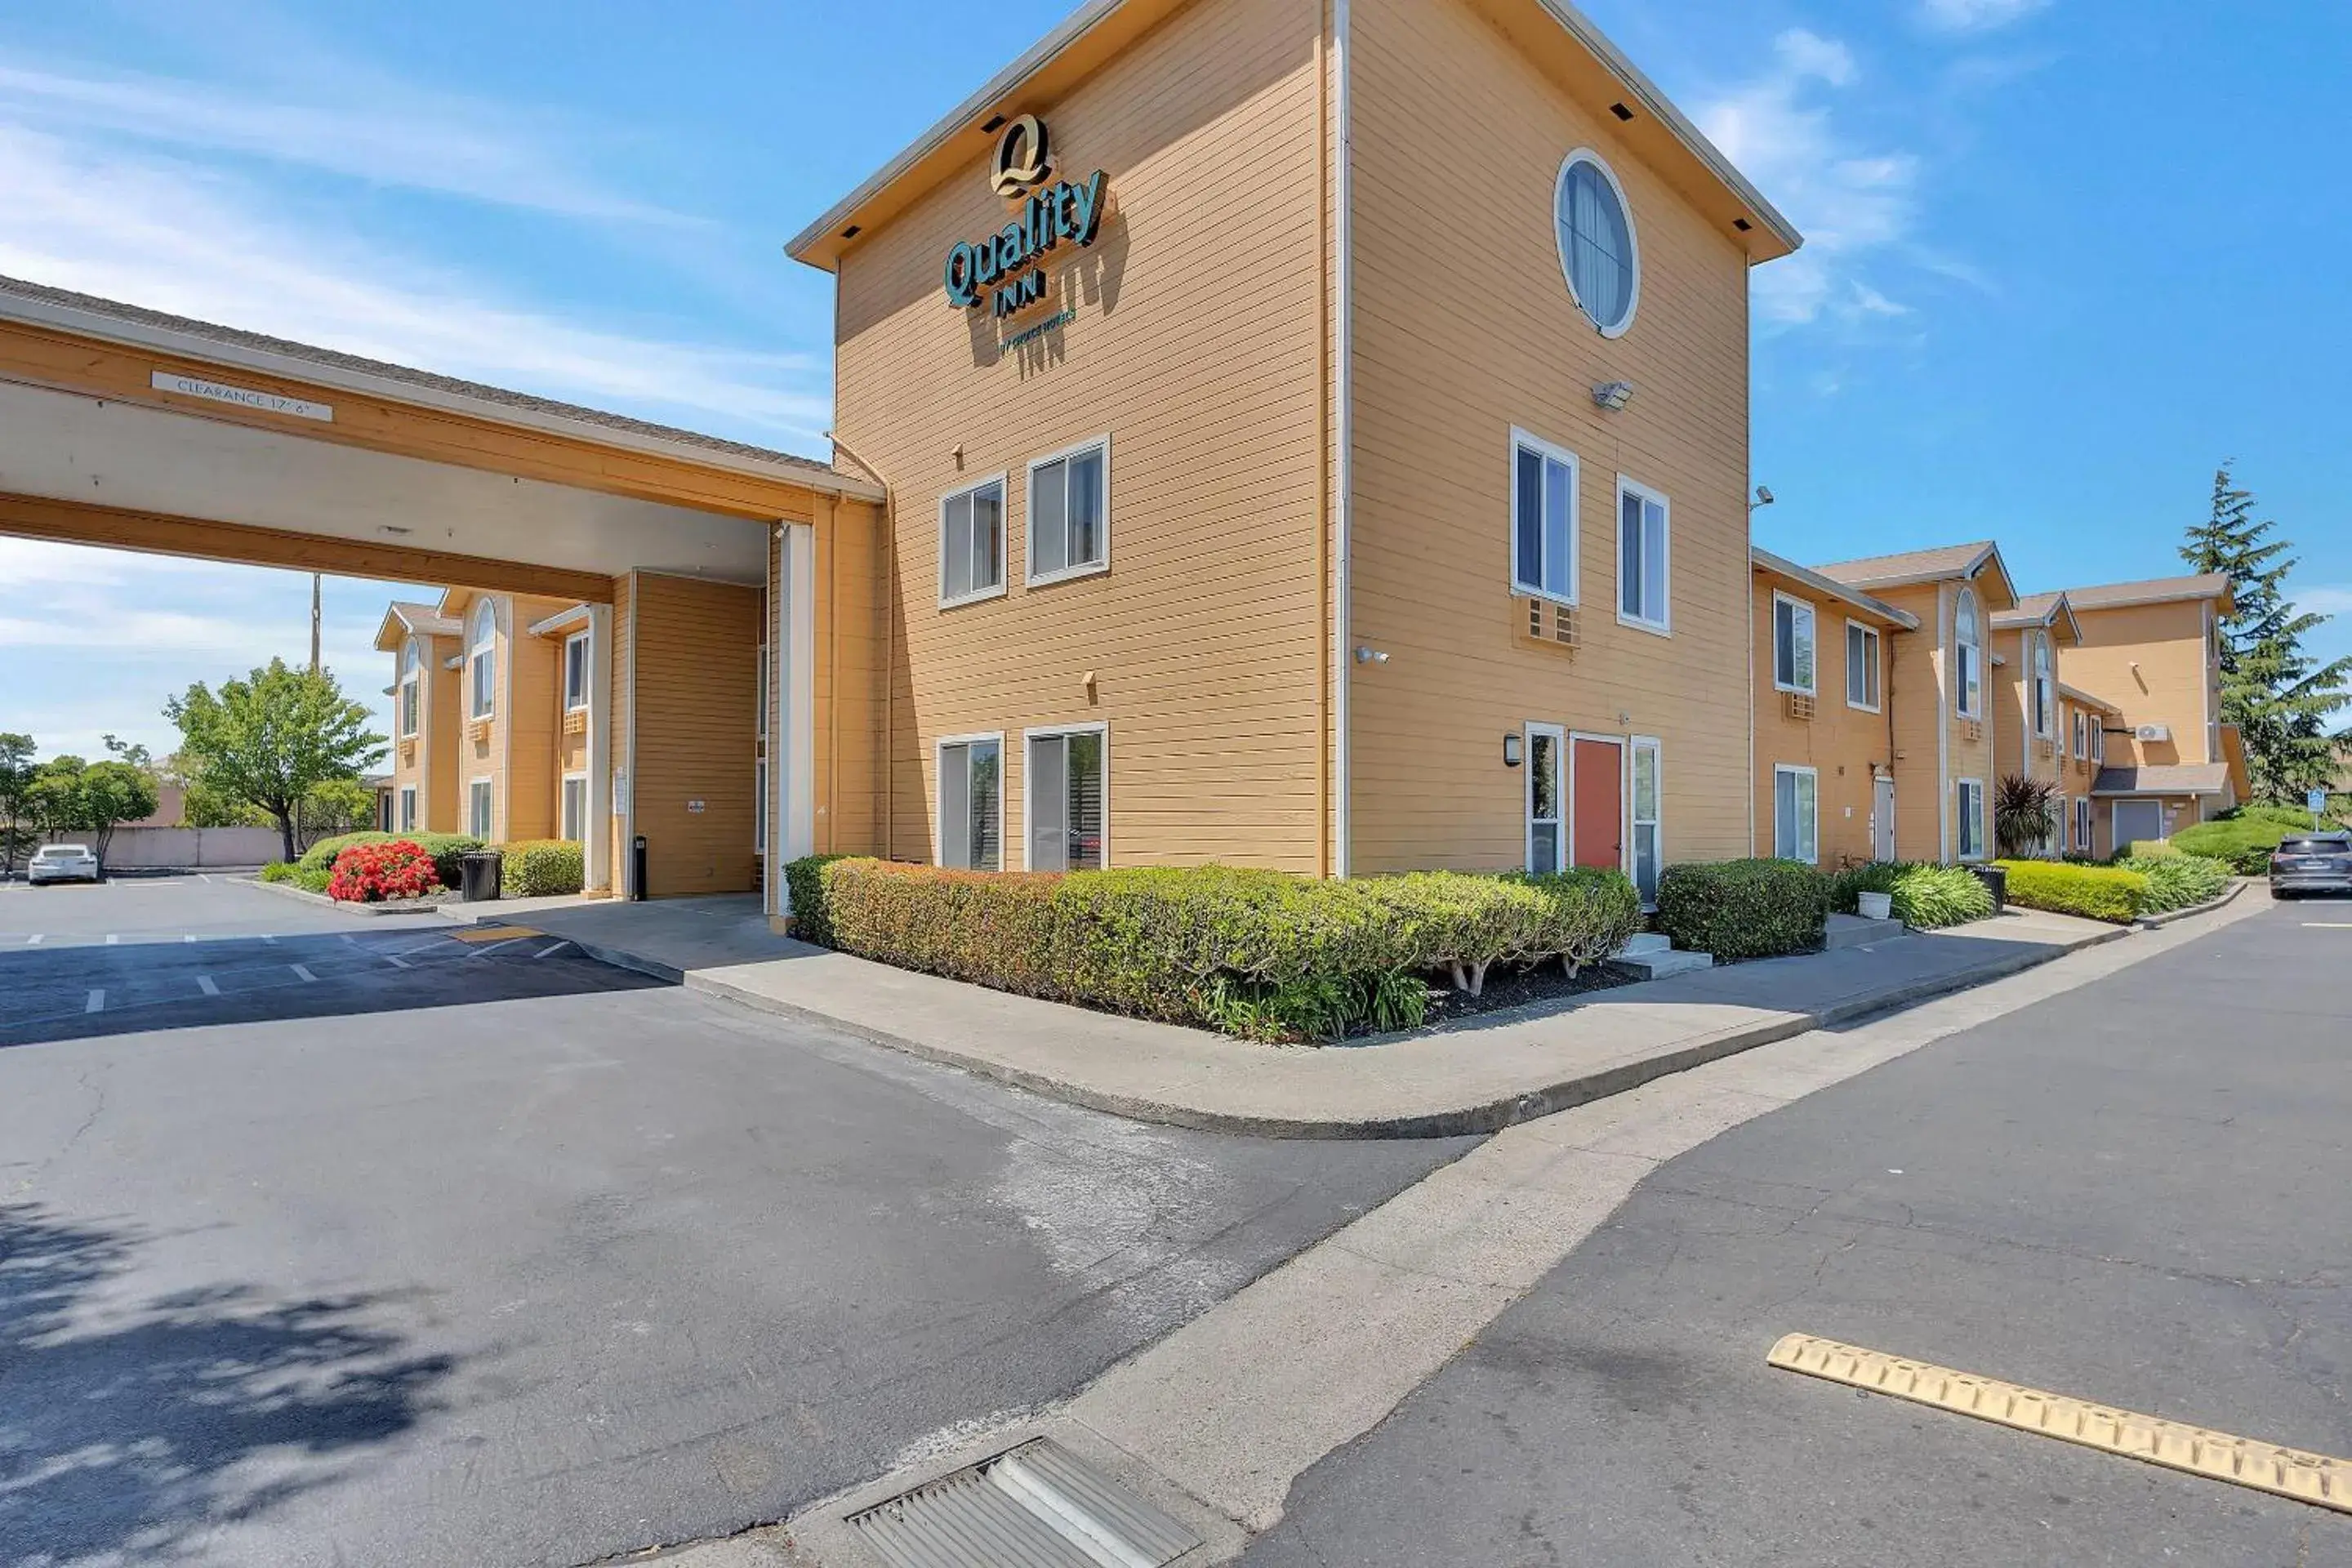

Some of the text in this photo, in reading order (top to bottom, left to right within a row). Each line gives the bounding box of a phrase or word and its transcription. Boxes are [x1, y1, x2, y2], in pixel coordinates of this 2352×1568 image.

[991, 114, 1049, 198] Q
[945, 169, 1106, 308] Quality
[993, 270, 1044, 318] INN
[176, 379, 264, 407] CLEARANCE
